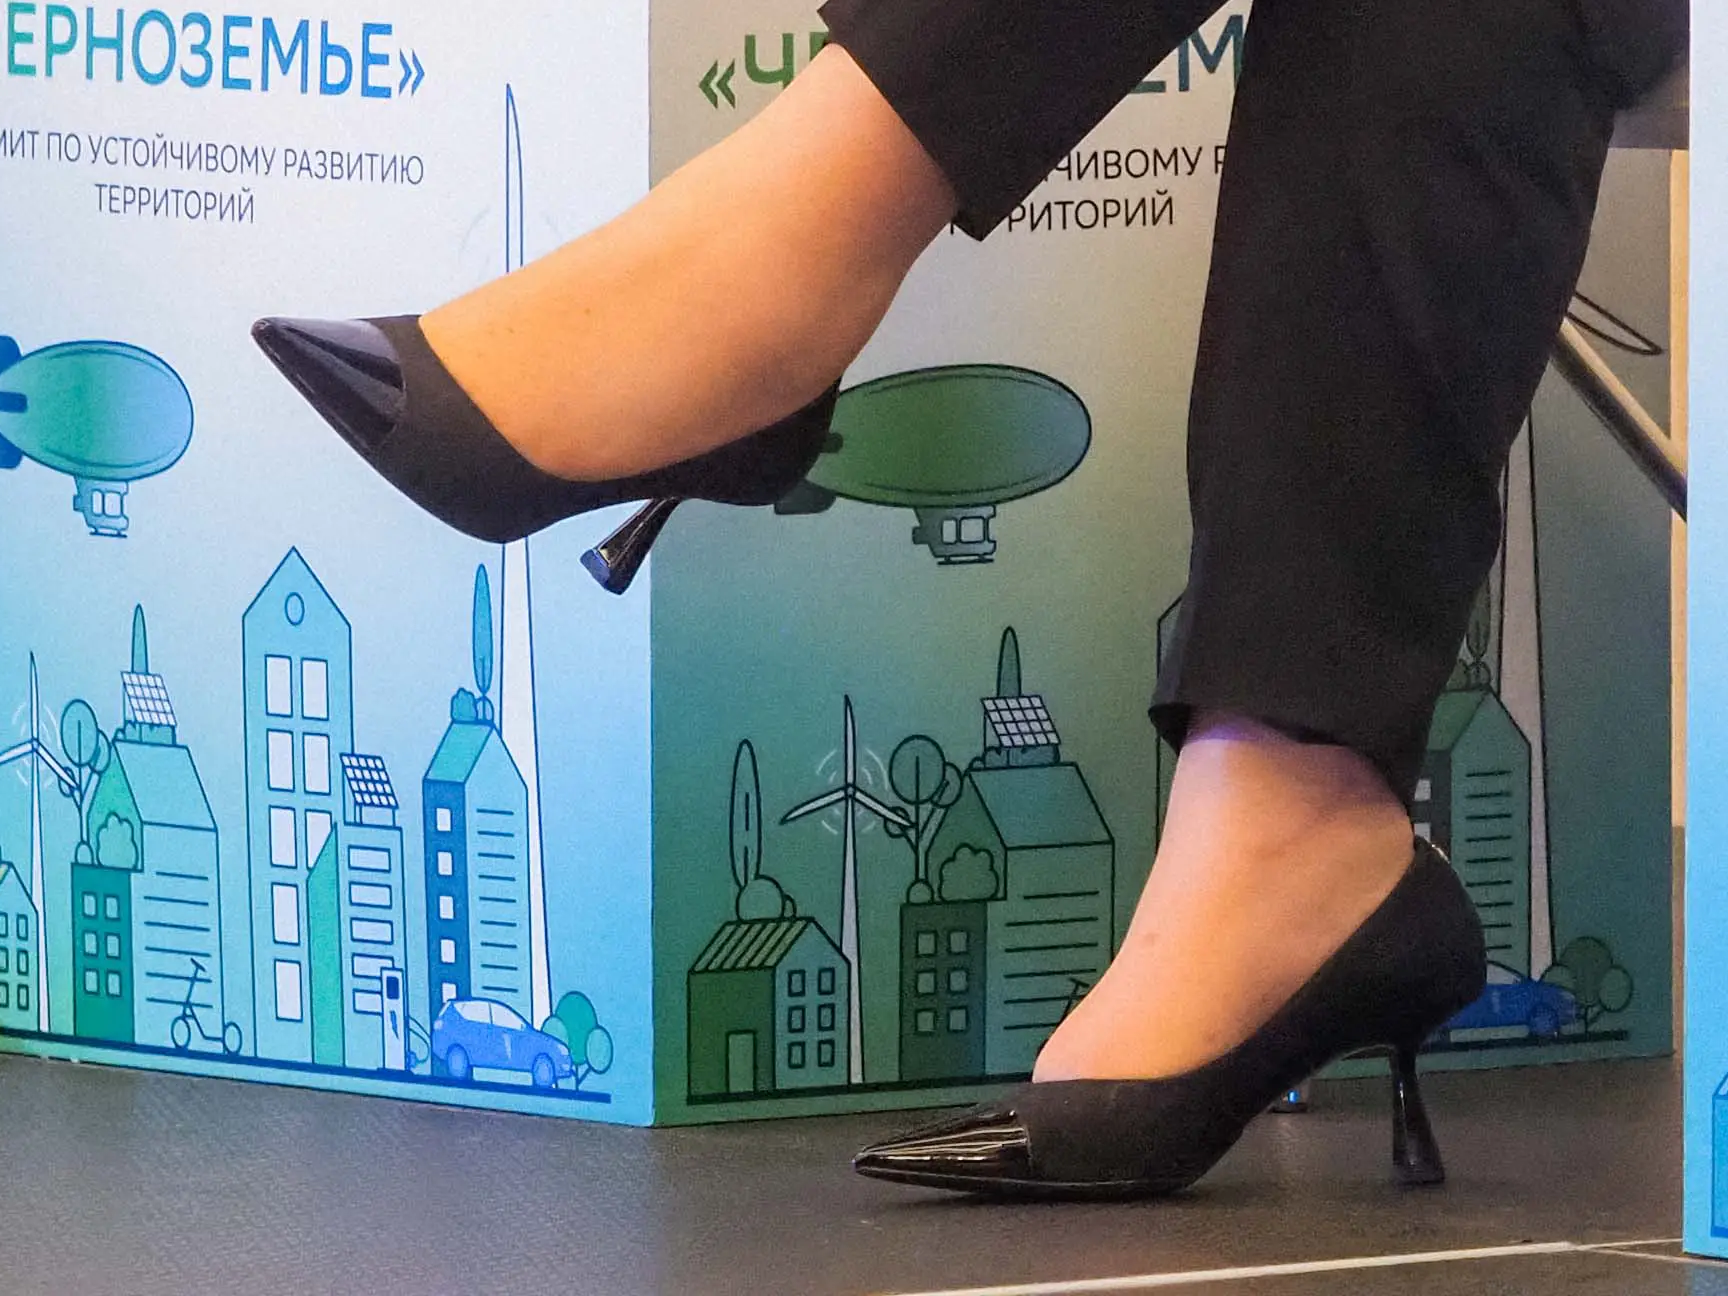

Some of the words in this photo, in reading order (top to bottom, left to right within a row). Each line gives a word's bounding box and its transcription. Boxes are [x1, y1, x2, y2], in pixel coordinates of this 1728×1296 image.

[46, 131, 82, 163] ПО
[87, 132, 276, 176] УСТОЙЧИВОМУ
[283, 147, 424, 186] РАЗВИТИЮ
[1044, 146, 1203, 185] ЧИВОМУ
[94, 182, 254, 223] ТЕРРИТОРИЙ
[950, 191, 1174, 235] РИТОРИЙ
